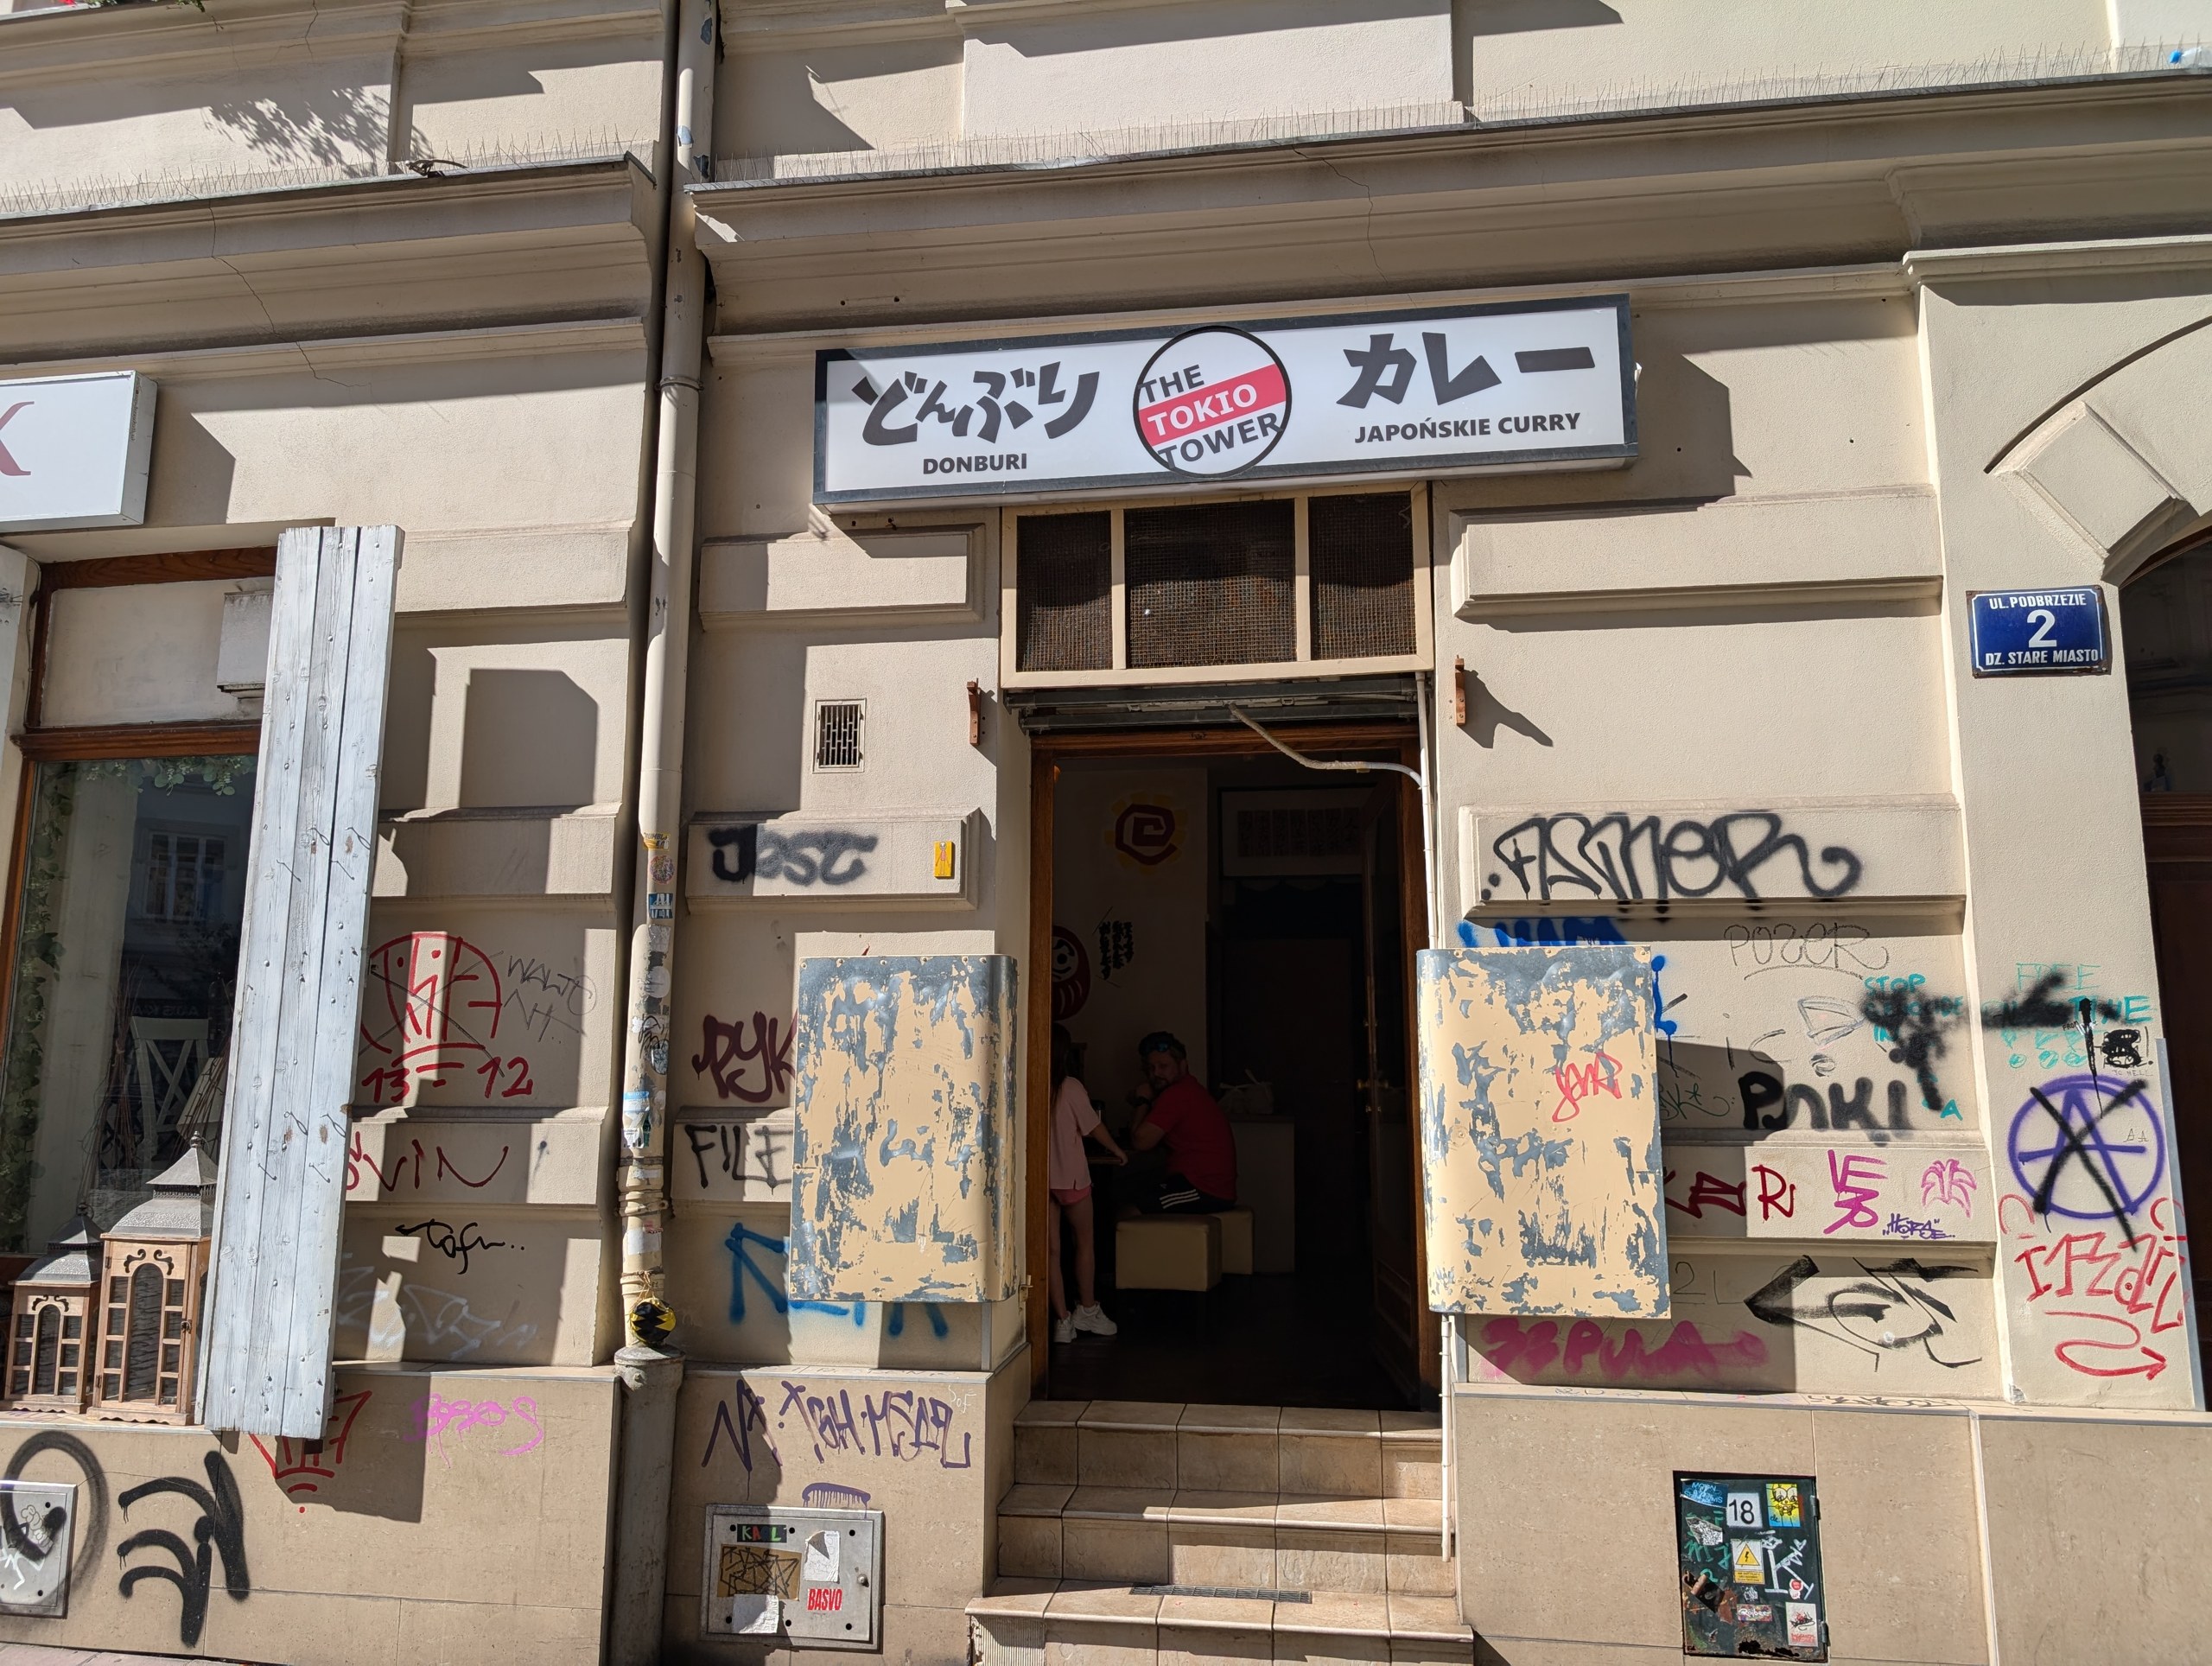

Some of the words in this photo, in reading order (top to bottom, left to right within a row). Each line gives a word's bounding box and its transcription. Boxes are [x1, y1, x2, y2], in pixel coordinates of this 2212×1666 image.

[1138, 364, 1205, 404] THE
[1336, 331, 1596, 409] カレー
[851, 361, 1100, 447] どんぶり
[1147, 384, 1258, 436] TOKIO
[1158, 412, 1283, 468] TOWER
[1354, 416, 1491, 444] JAPOŃSKIE
[1497, 412, 1581, 434] CURRY
[923, 453, 1027, 475] DONBURI
[1988, 597, 2010, 610] UL.
[2009, 593, 2088, 609] PODBRZEZIE
[2026, 608, 2058, 648] 2
[1985, 652, 2005, 666] DZ.
[2007, 650, 2049, 665] STARE
[2052, 648, 2099, 663] MIASTO
[1864, 973, 1926, 995] STOP
[1728, 1498, 1755, 1524] 18
[807, 1588, 843, 1612] BASVO
